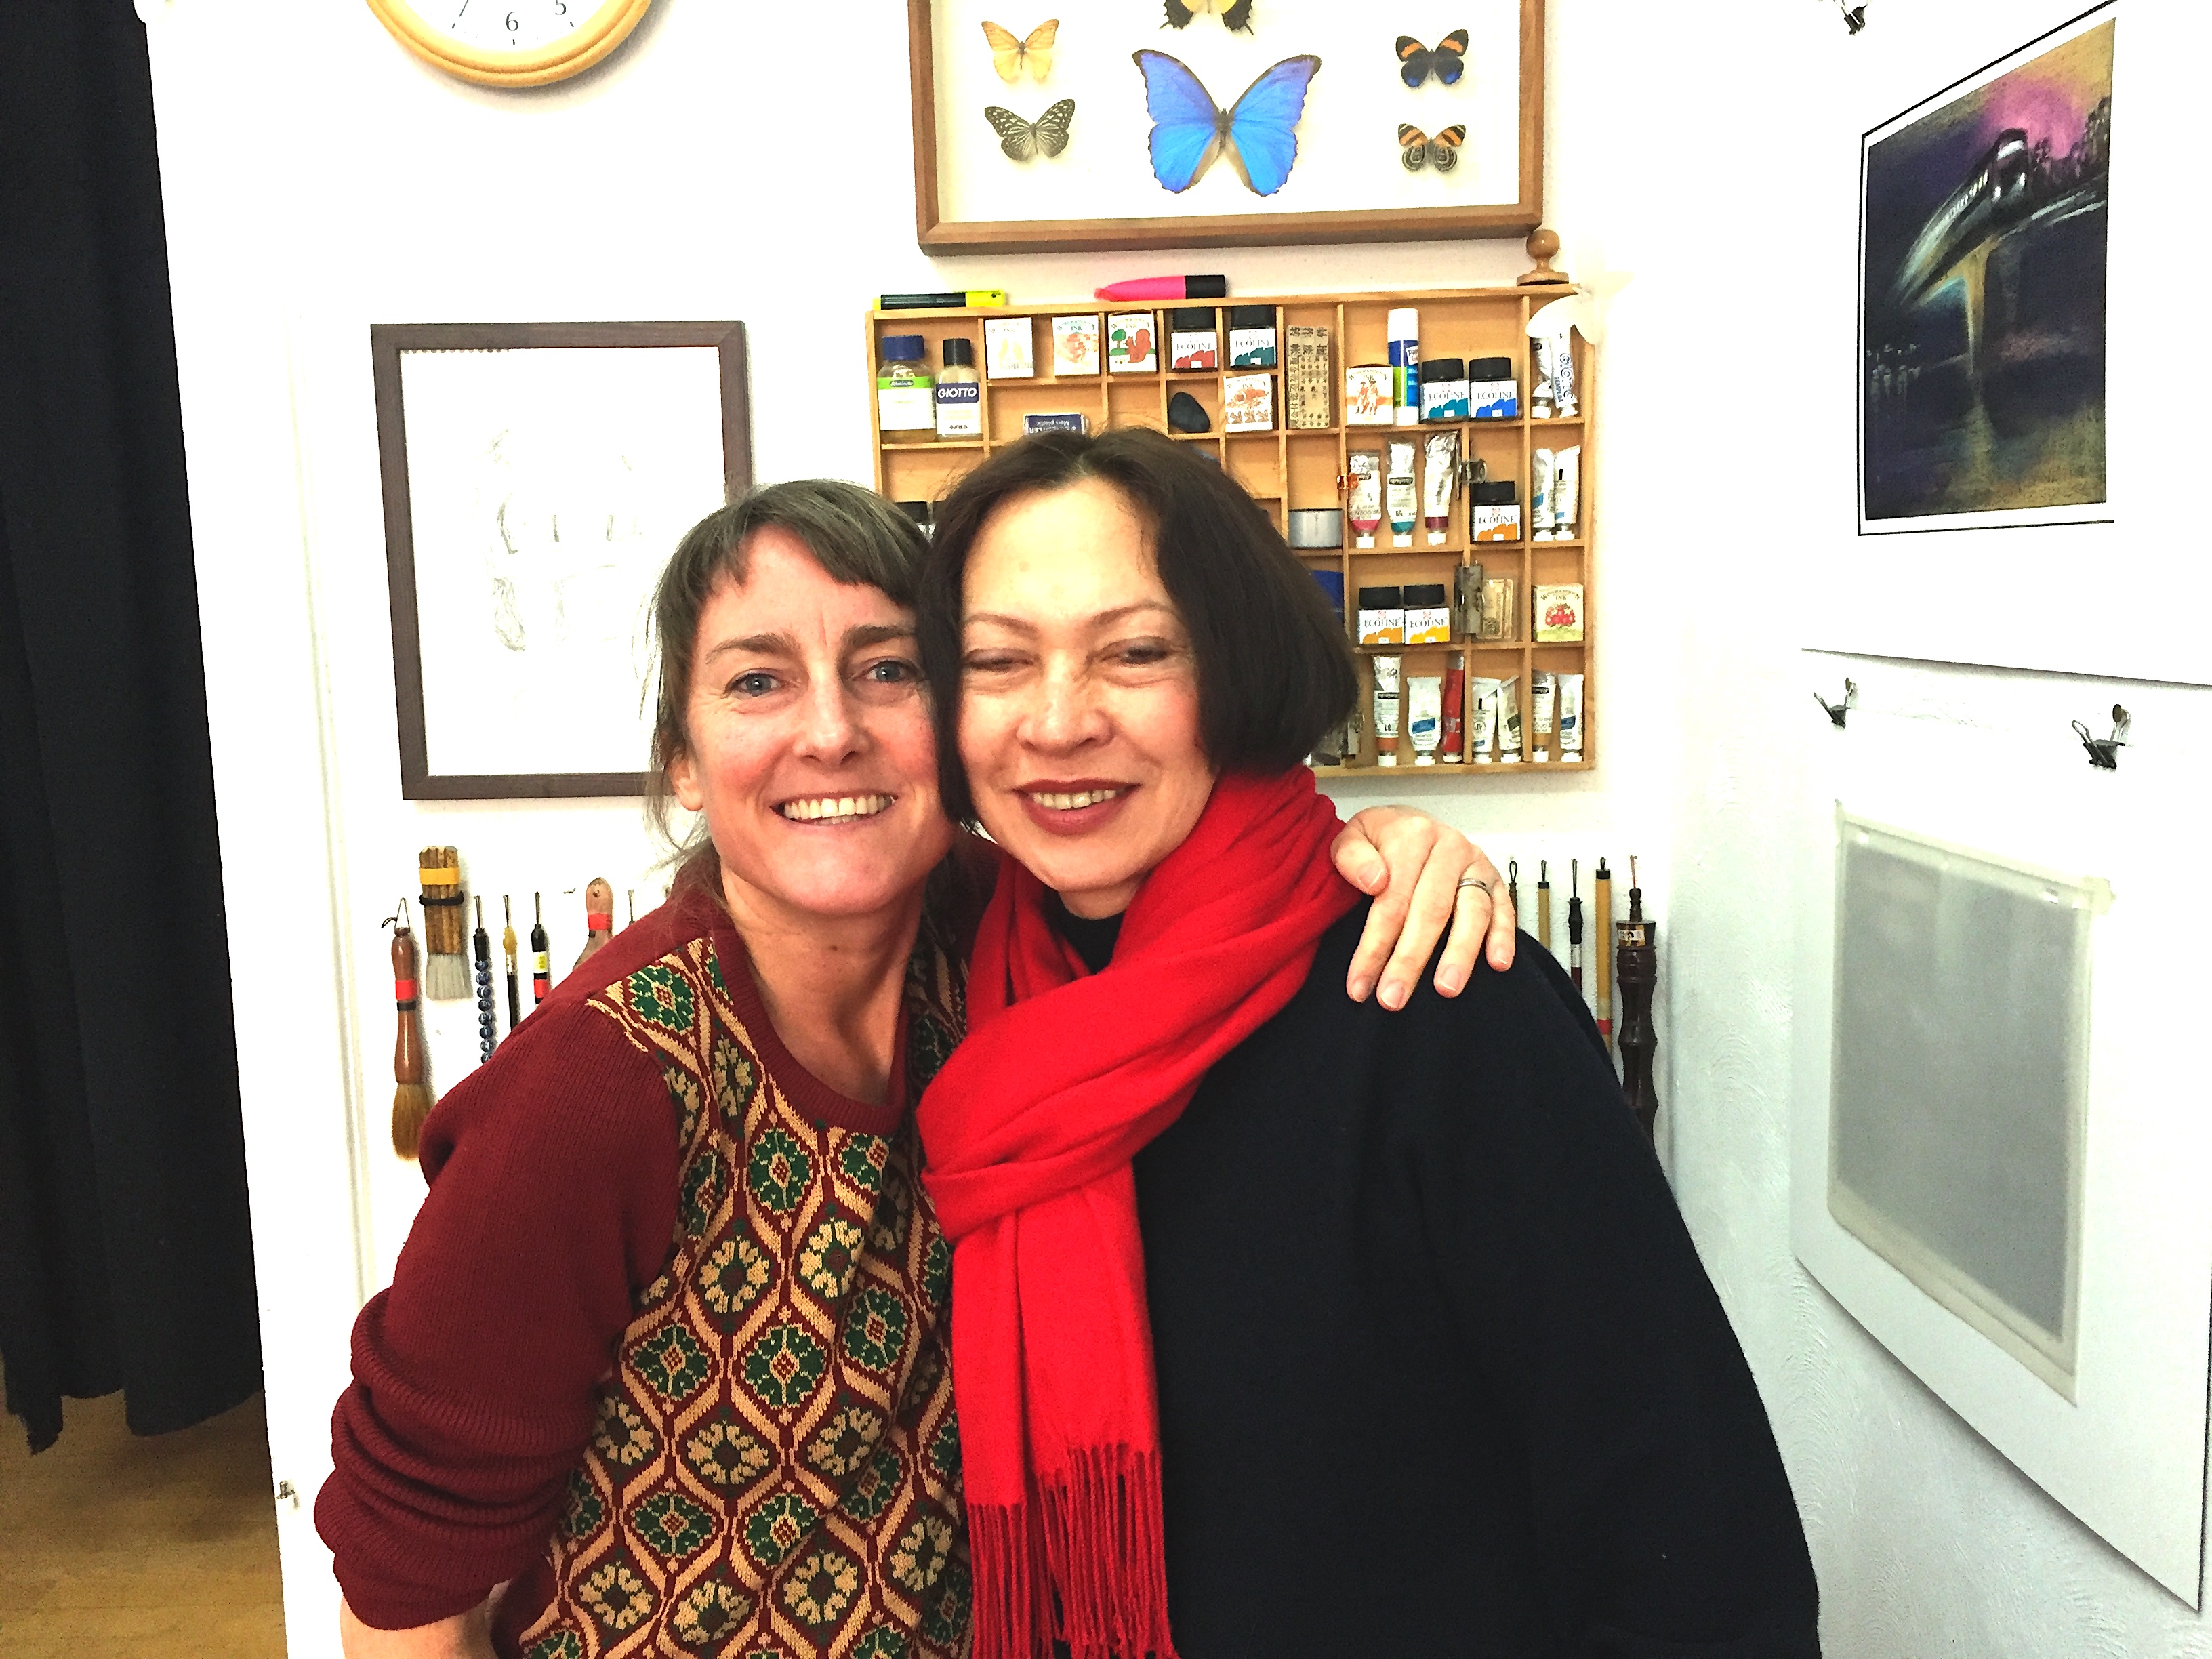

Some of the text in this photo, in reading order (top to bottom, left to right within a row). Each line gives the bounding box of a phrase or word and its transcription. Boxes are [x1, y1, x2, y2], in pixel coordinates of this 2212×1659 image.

[506, 12, 519, 32] 6
[937, 387, 977, 398] GIOTTO
[1429, 392, 1465, 401] ECOLINE
[1477, 391, 1513, 400] ECOLINE
[1479, 516, 1515, 524] ECOLINE
[1364, 619, 1400, 628] ECOLINE
[1410, 618, 1446, 628] ECOLINE
